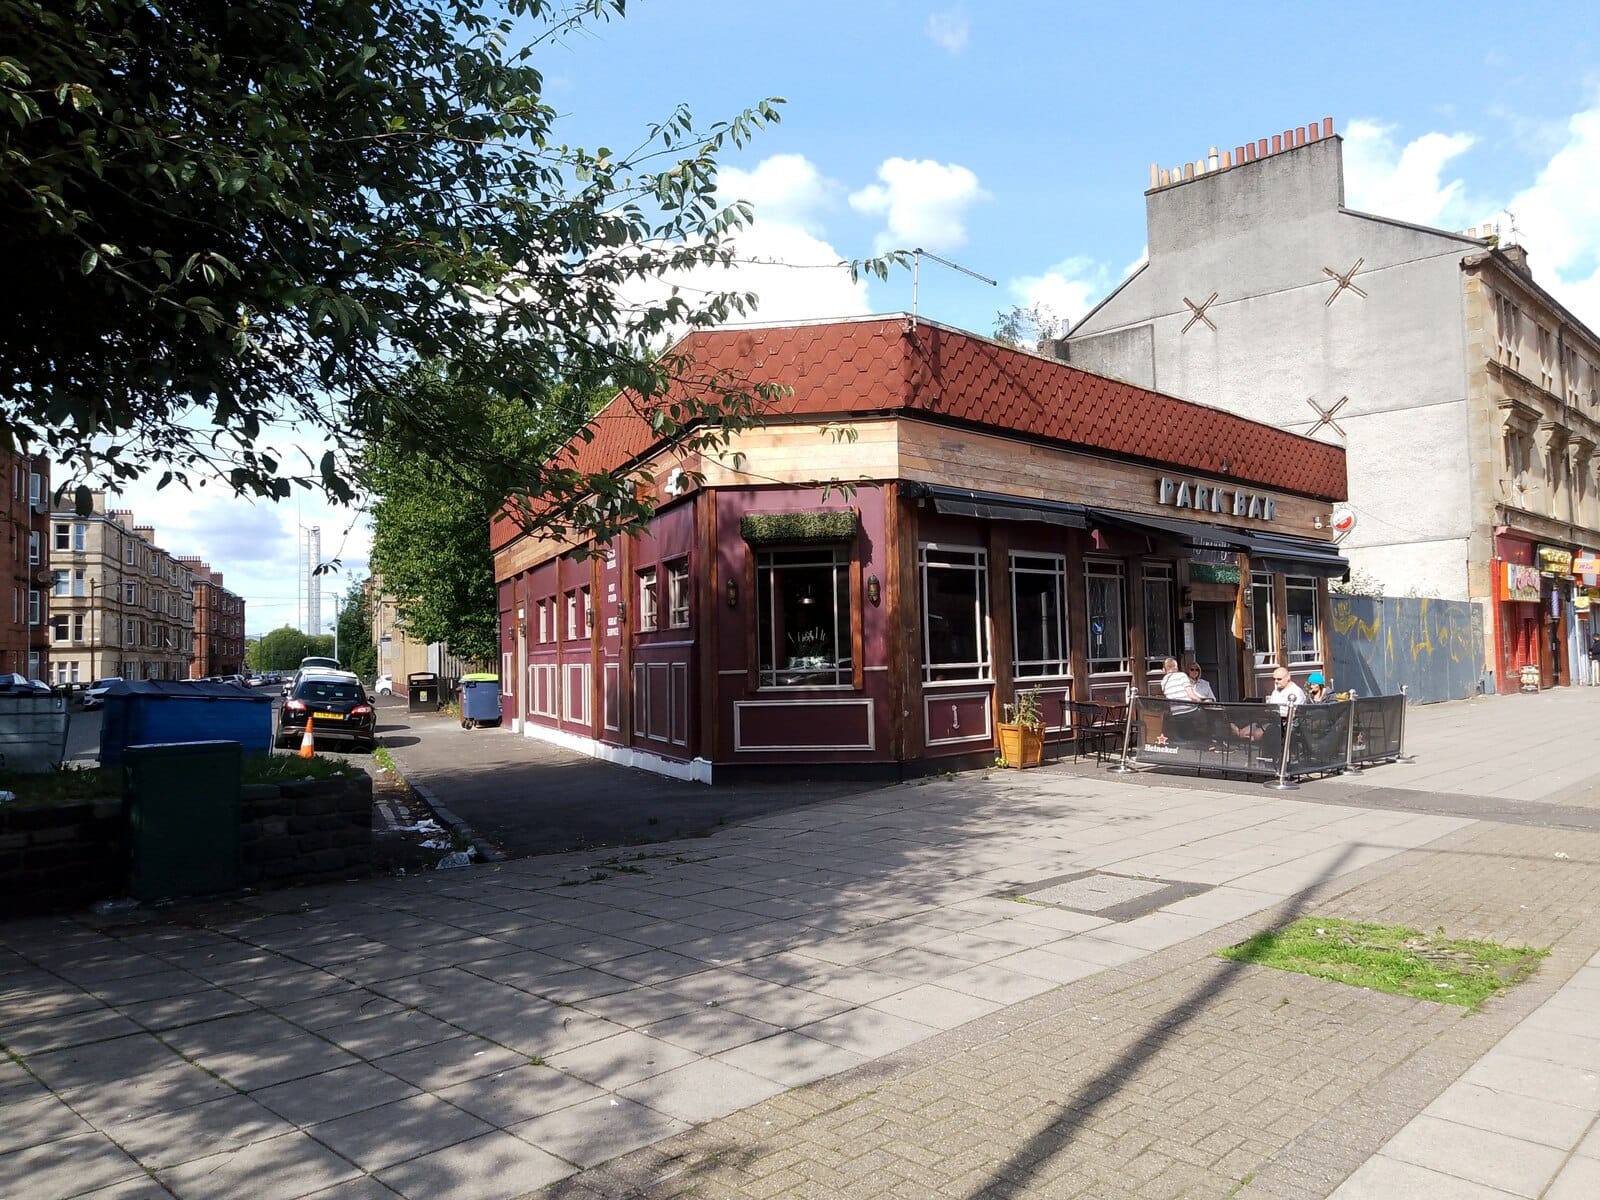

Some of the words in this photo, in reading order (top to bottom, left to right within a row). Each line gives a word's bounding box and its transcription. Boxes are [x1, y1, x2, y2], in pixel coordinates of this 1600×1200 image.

[1159, 477, 1225, 513] PARK
[1232, 490, 1276, 520] BAR
[1144, 743, 1179, 754] Heineken
